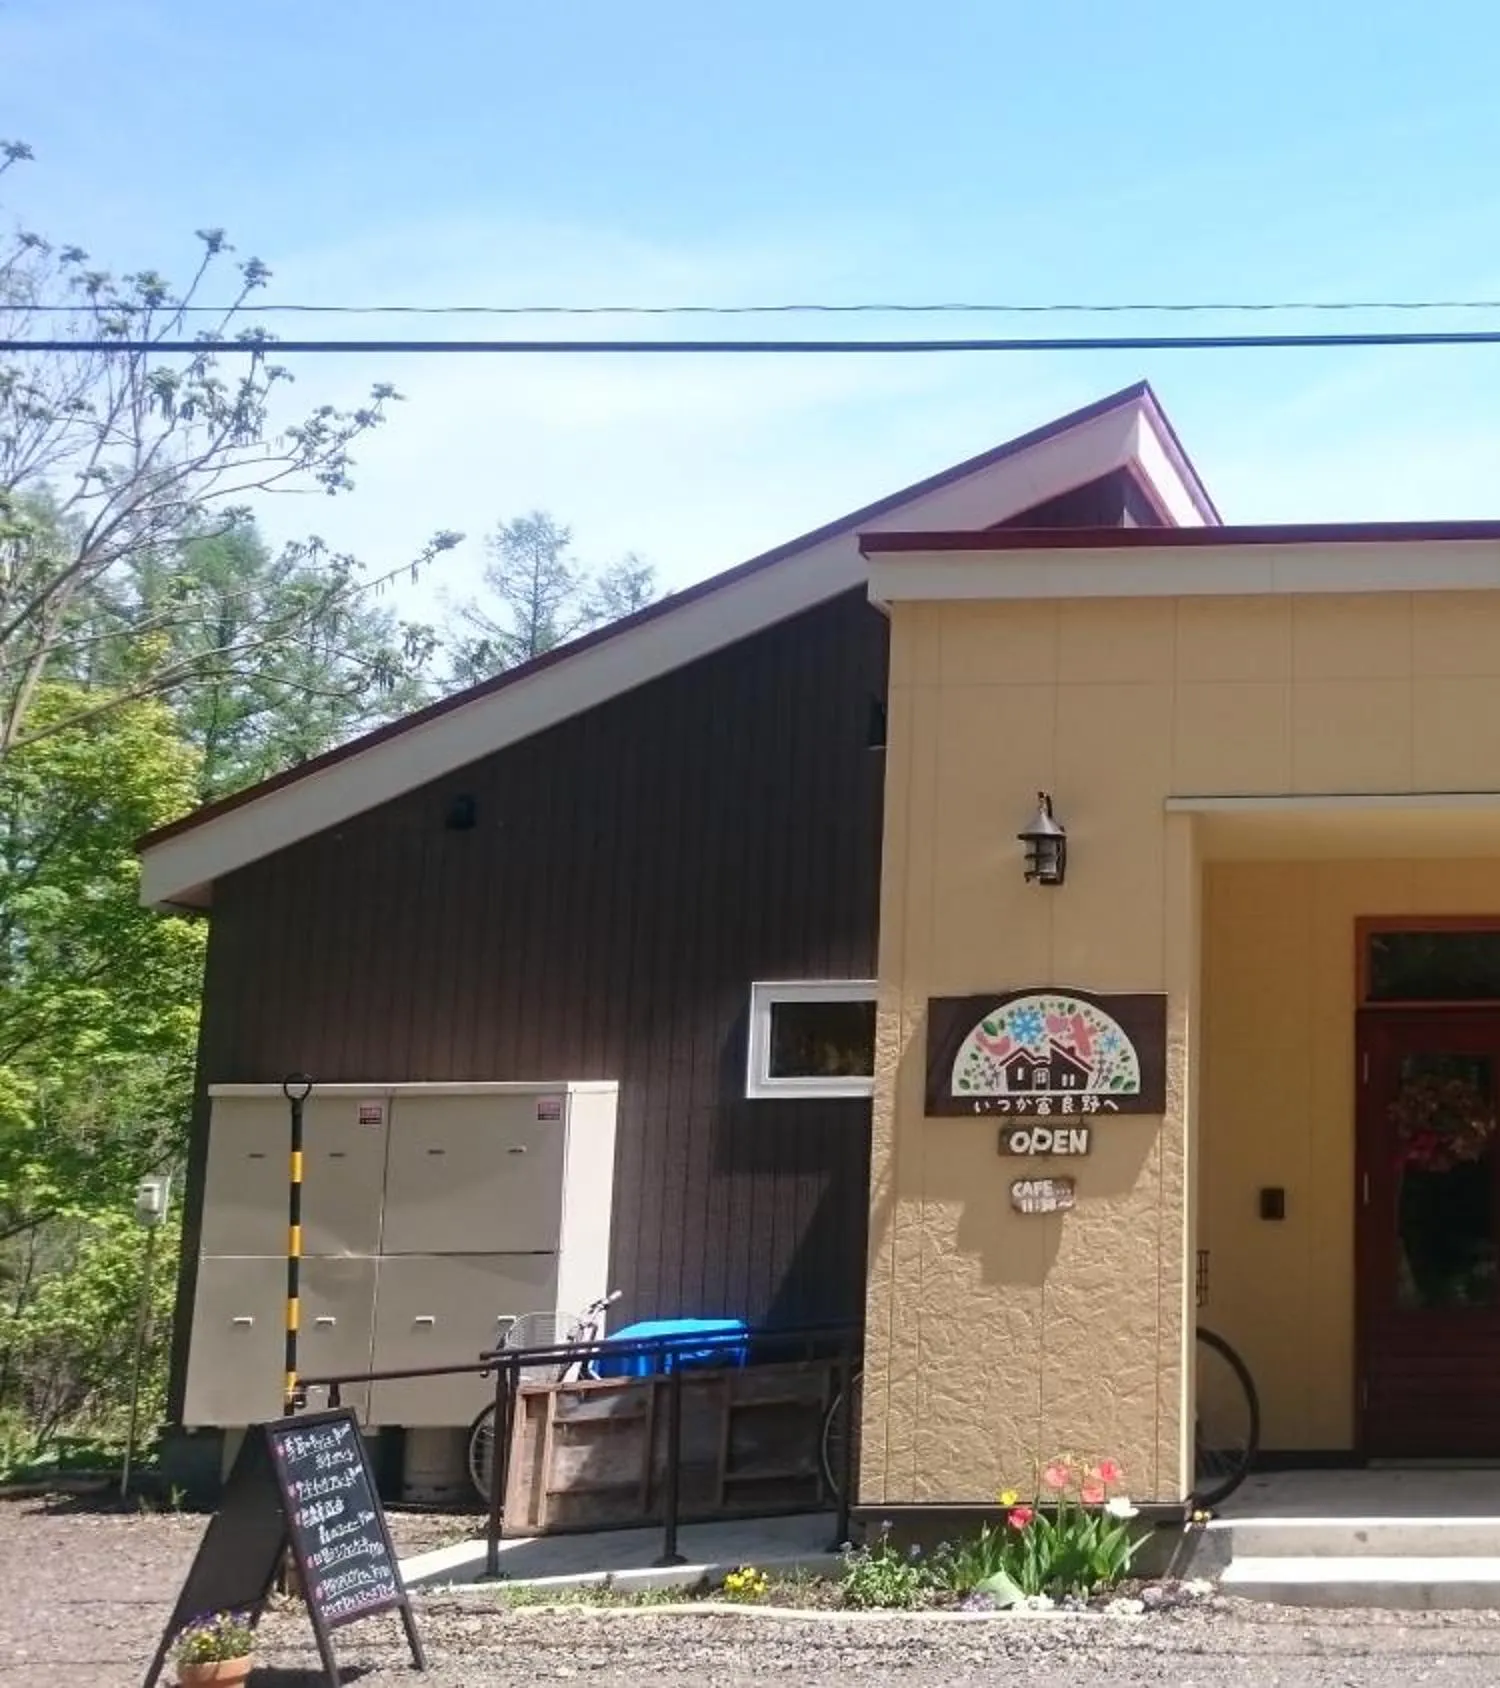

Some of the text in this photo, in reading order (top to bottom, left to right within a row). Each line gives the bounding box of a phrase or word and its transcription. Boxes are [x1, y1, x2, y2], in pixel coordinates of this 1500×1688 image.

[973, 1096, 1120, 1115] いつか富良野へ
[1009, 1127, 1089, 1155] OPEN
